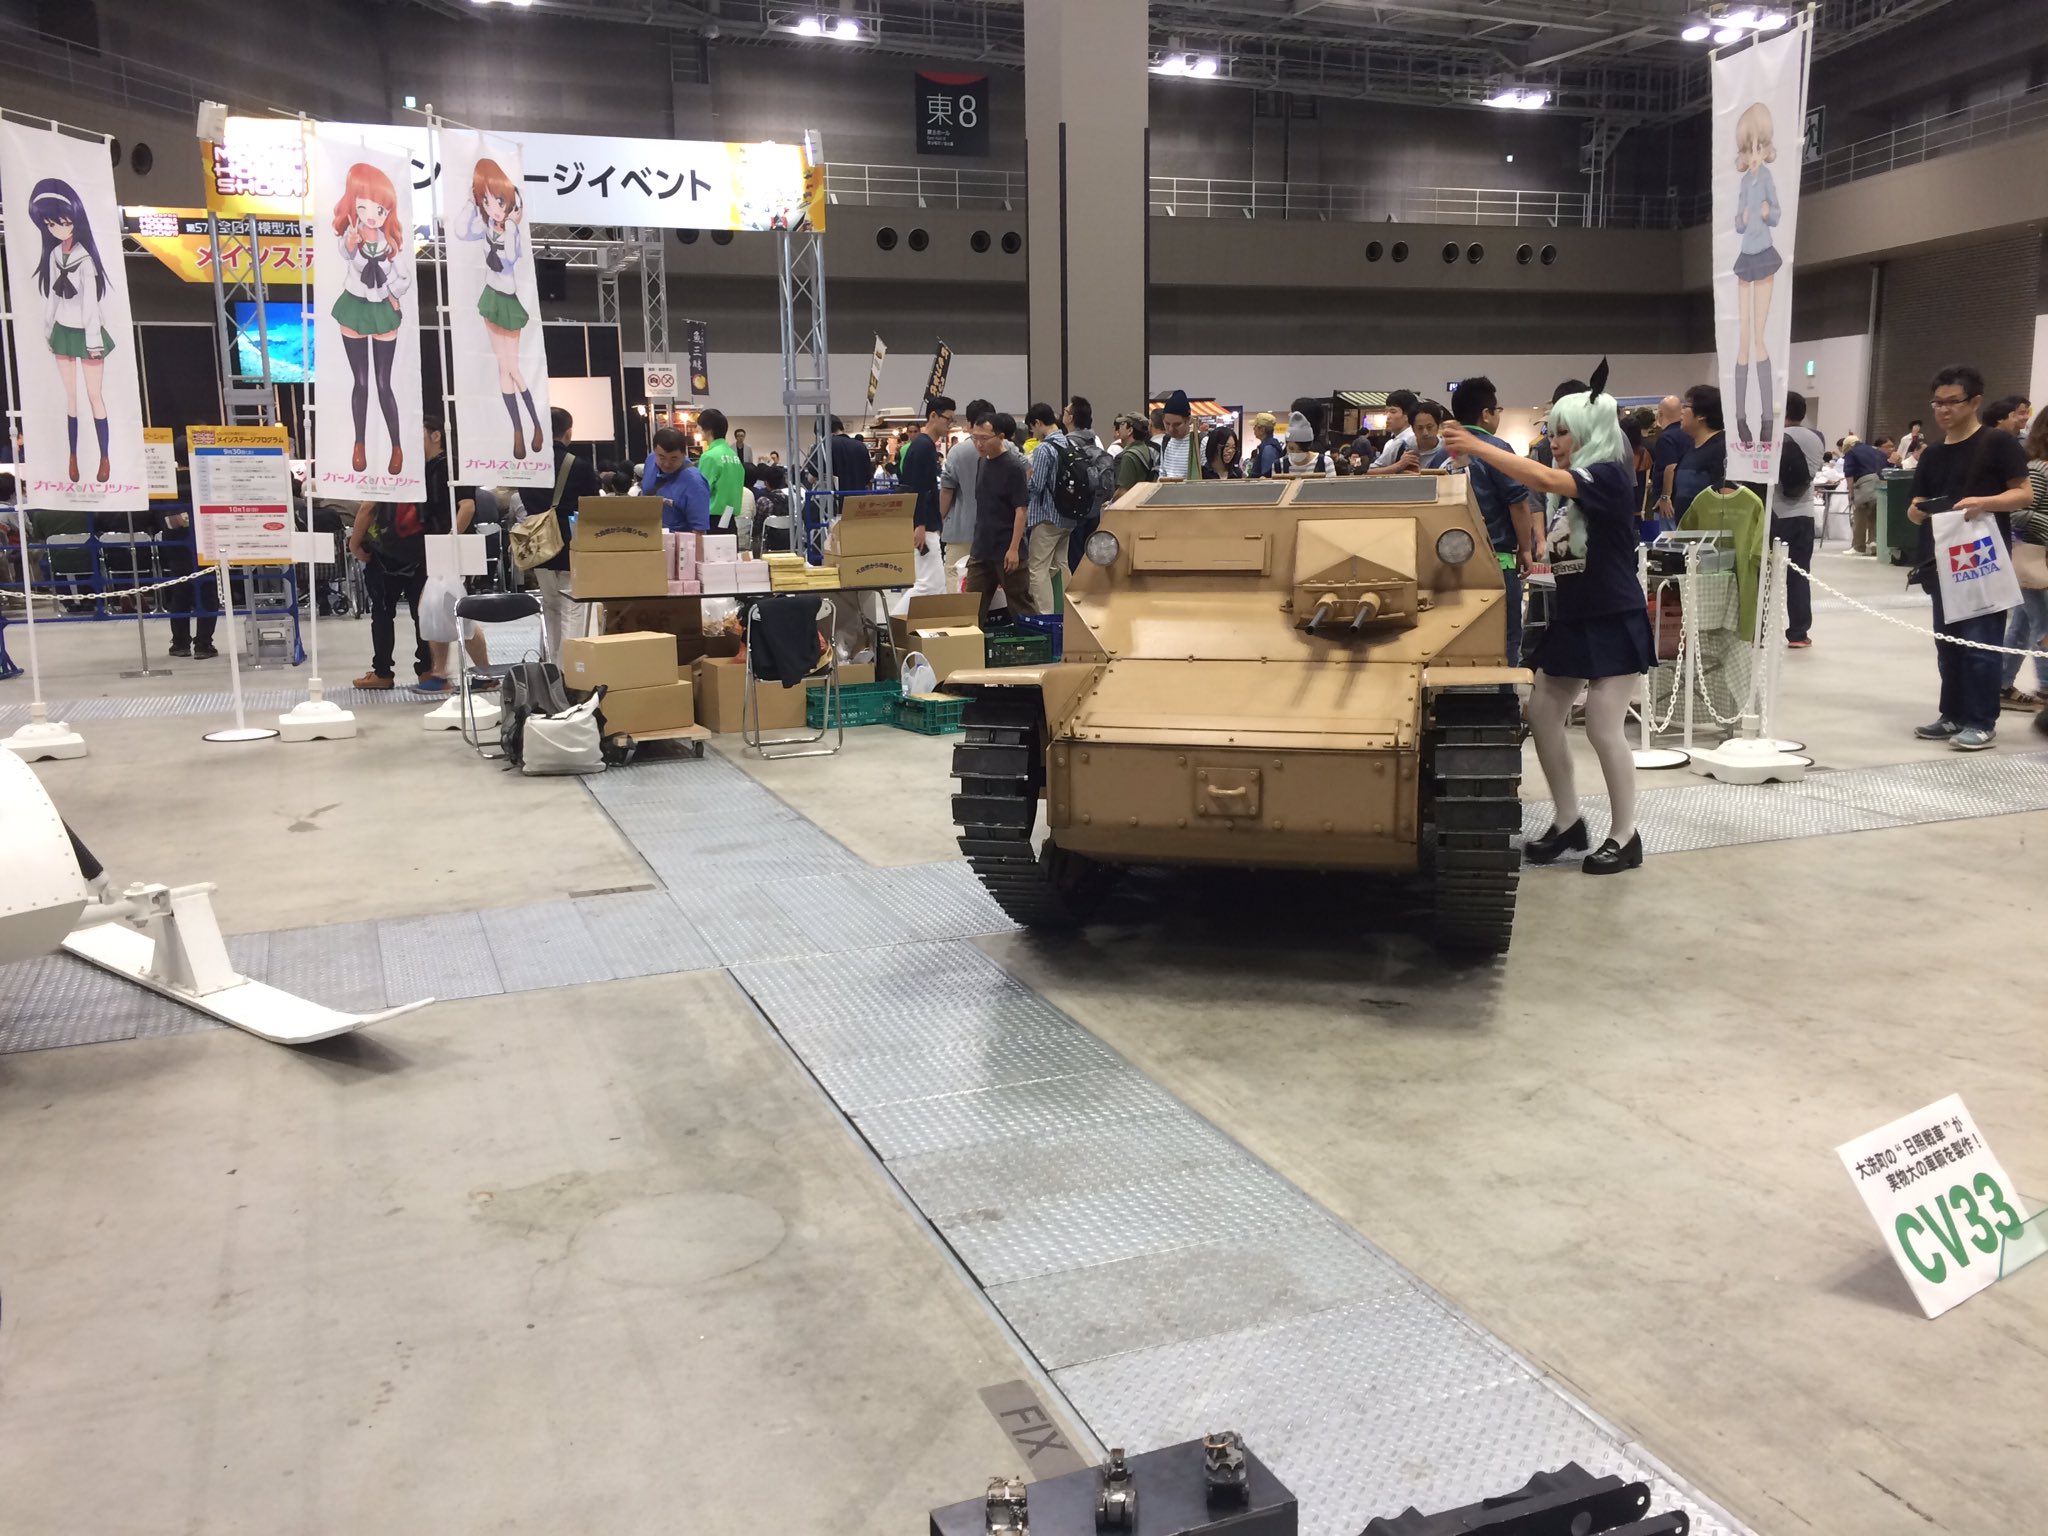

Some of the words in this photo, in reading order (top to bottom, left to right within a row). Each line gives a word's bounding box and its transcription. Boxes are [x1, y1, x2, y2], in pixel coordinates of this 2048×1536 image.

[216, 436, 284, 444] メインステージプログラム
[1951, 562, 2001, 583] TAMIYA
[1895, 1172, 2025, 1284] CV33
[1000, 1405, 1069, 1459] FIX
